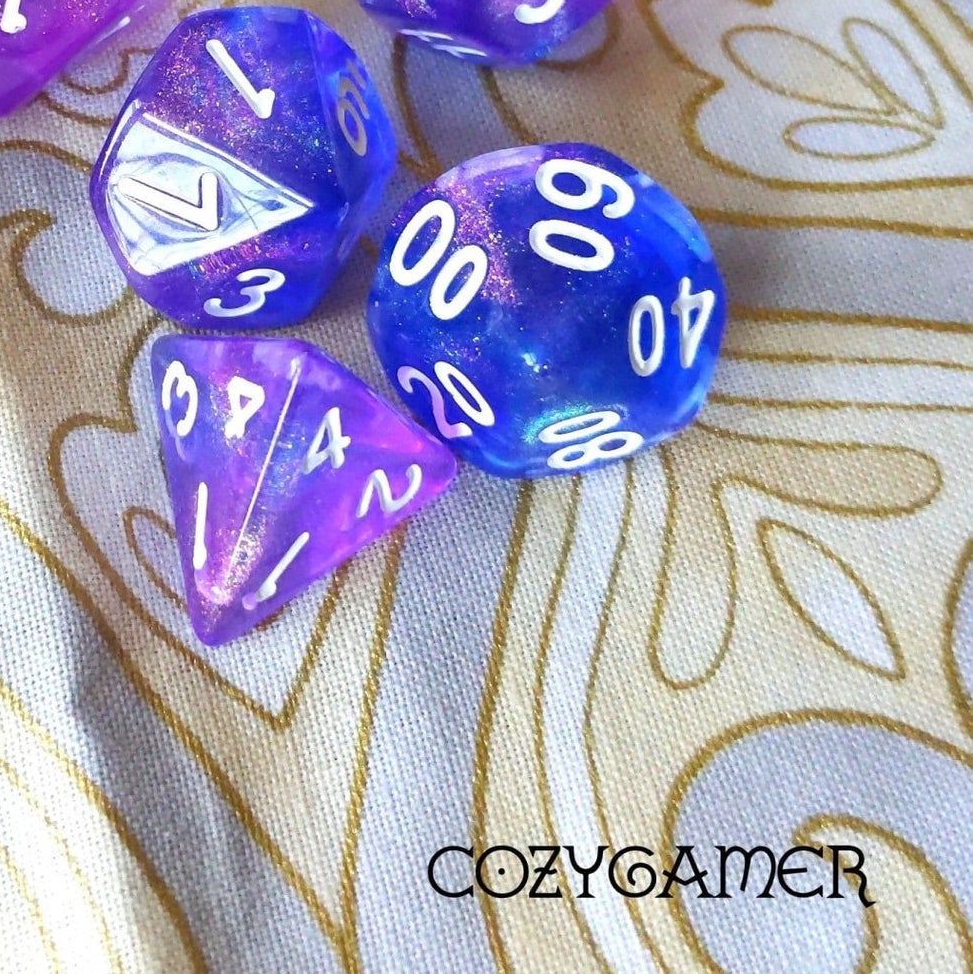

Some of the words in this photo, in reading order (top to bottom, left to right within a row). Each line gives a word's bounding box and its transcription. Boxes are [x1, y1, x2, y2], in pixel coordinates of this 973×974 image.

[206, 39, 275, 118] 1
[204, 268, 285, 317] 3
[389, 199, 488, 320] 00
[629, 277, 715, 376] 40
[162, 361, 198, 436] 3
[225, 376, 265, 438] 4
[398, 361, 495, 439] 20
[302, 407, 351, 474] 4
[538, 410, 643, 468] 80
[193, 482, 208, 570] 1
[356, 464, 422, 518] 2
[255, 532, 309, 602] 1
